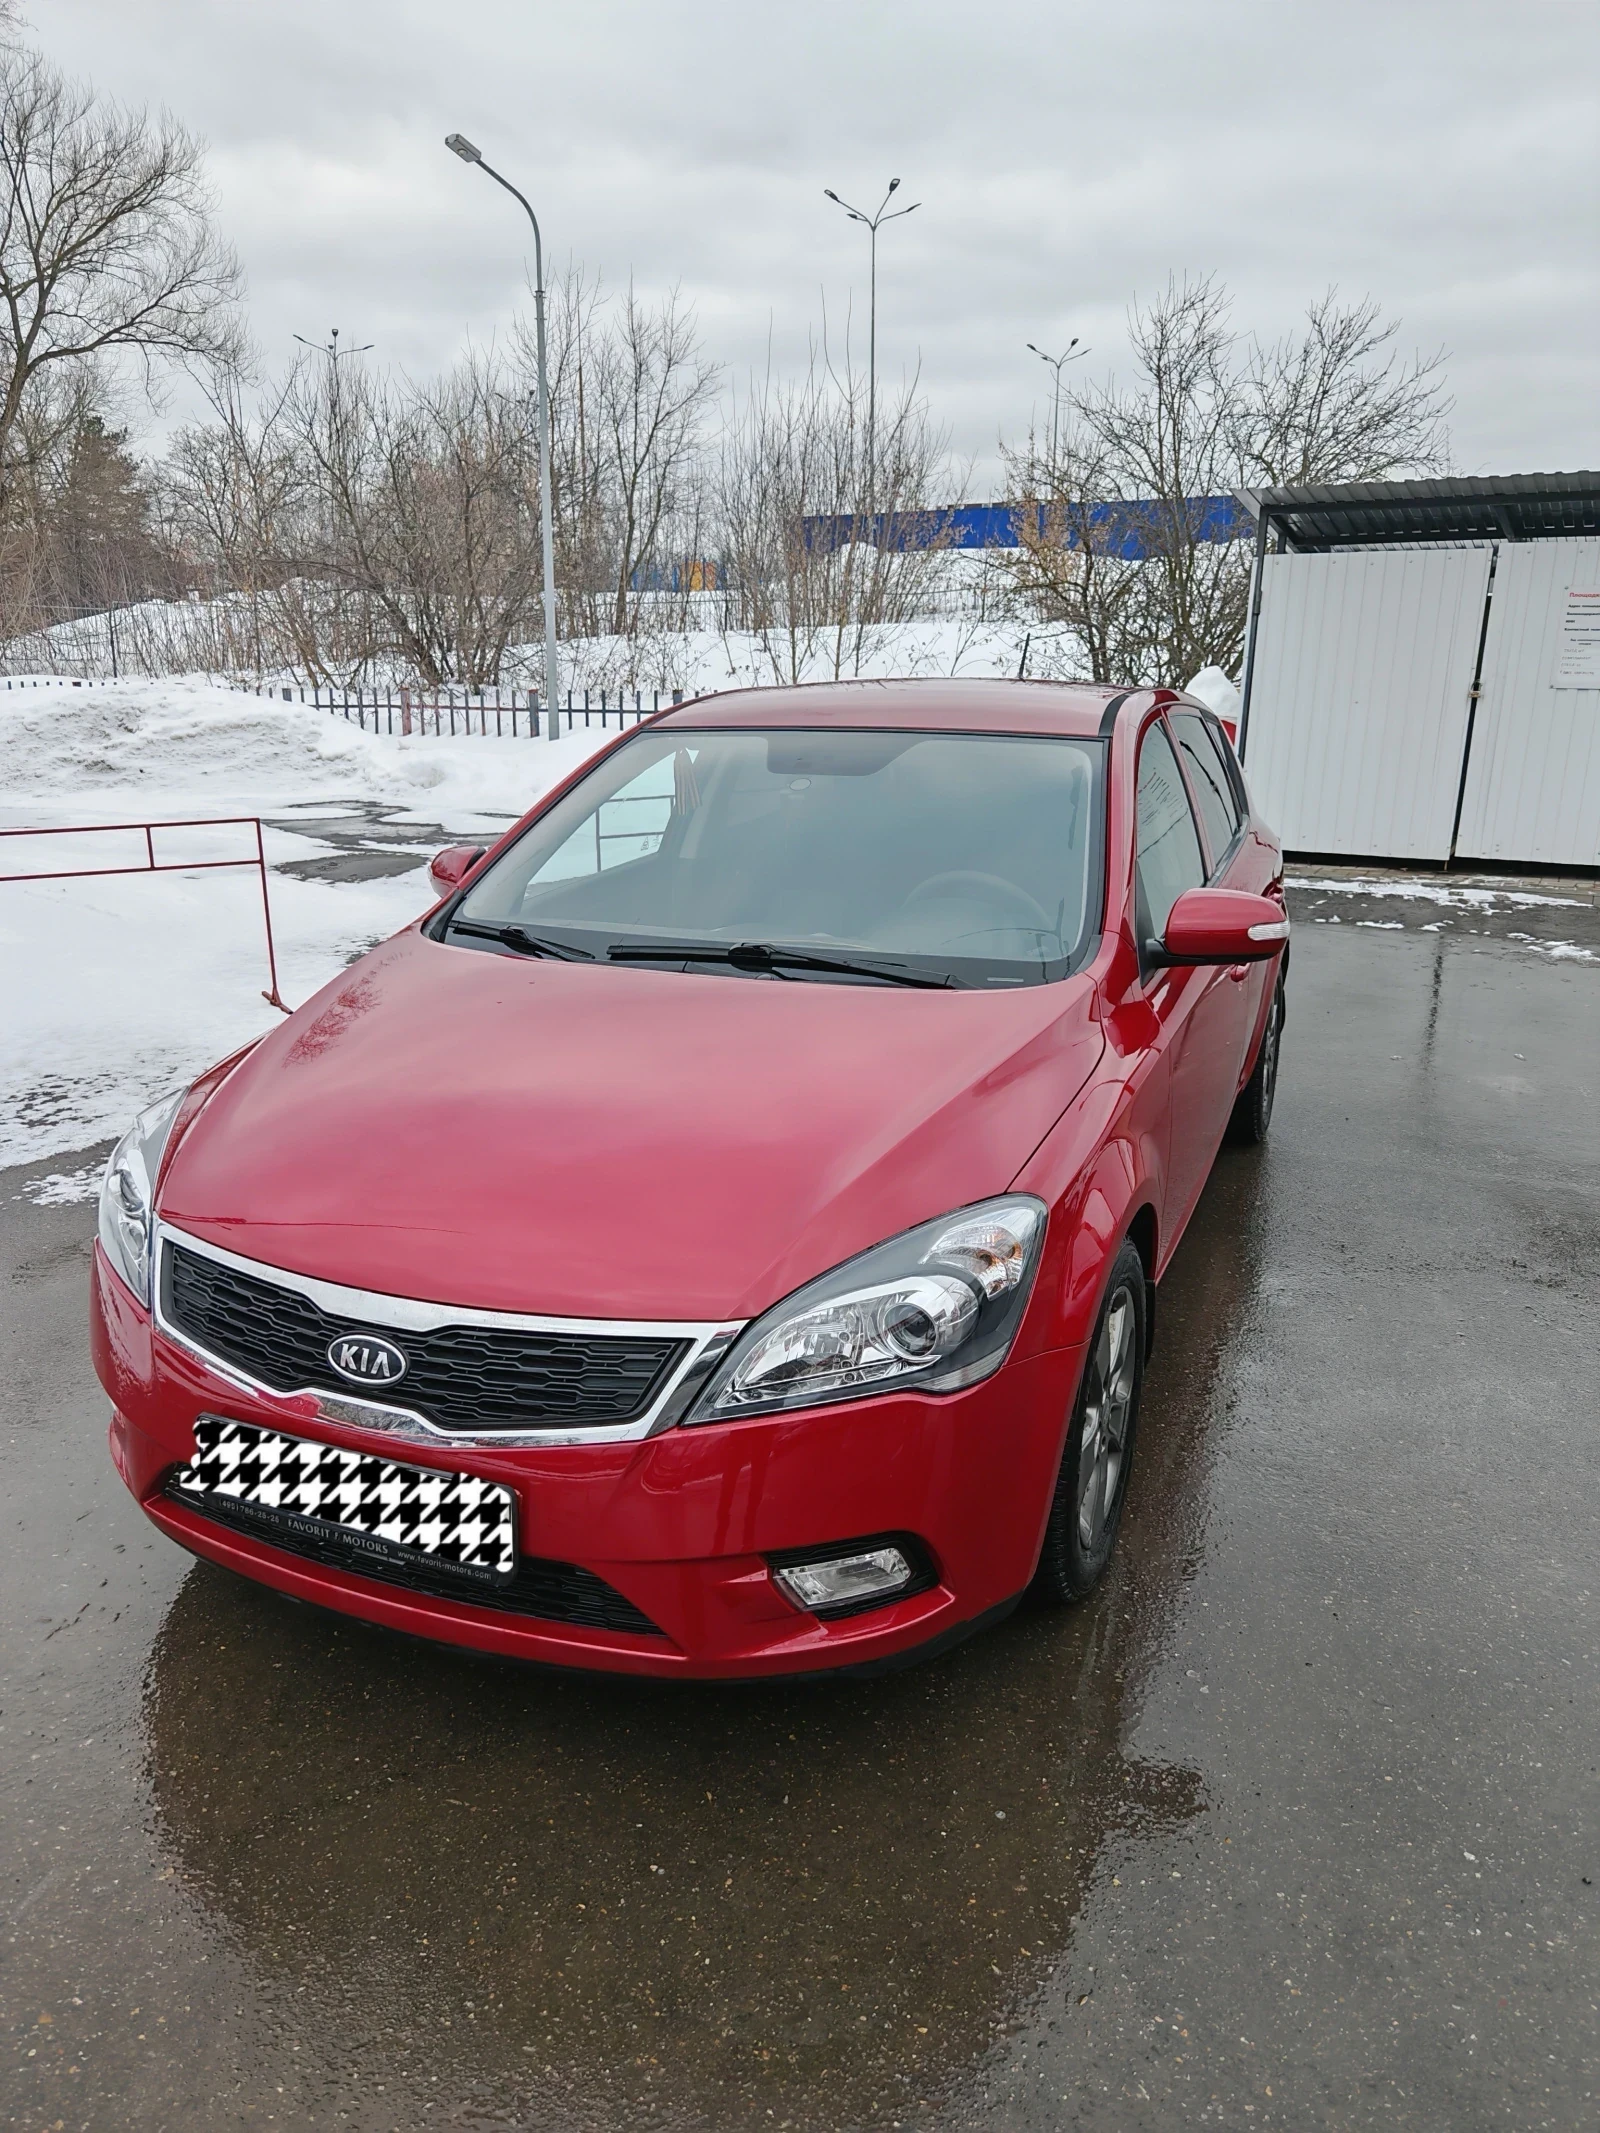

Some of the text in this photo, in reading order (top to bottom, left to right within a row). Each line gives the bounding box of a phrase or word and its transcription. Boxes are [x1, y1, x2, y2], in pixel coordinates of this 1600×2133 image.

[340, 1343, 391, 1377] KIA
[288, 1519, 389, 1554] FAVORIT MOTORS
[397, 1550, 492, 1580] www.favorit-motors.com
